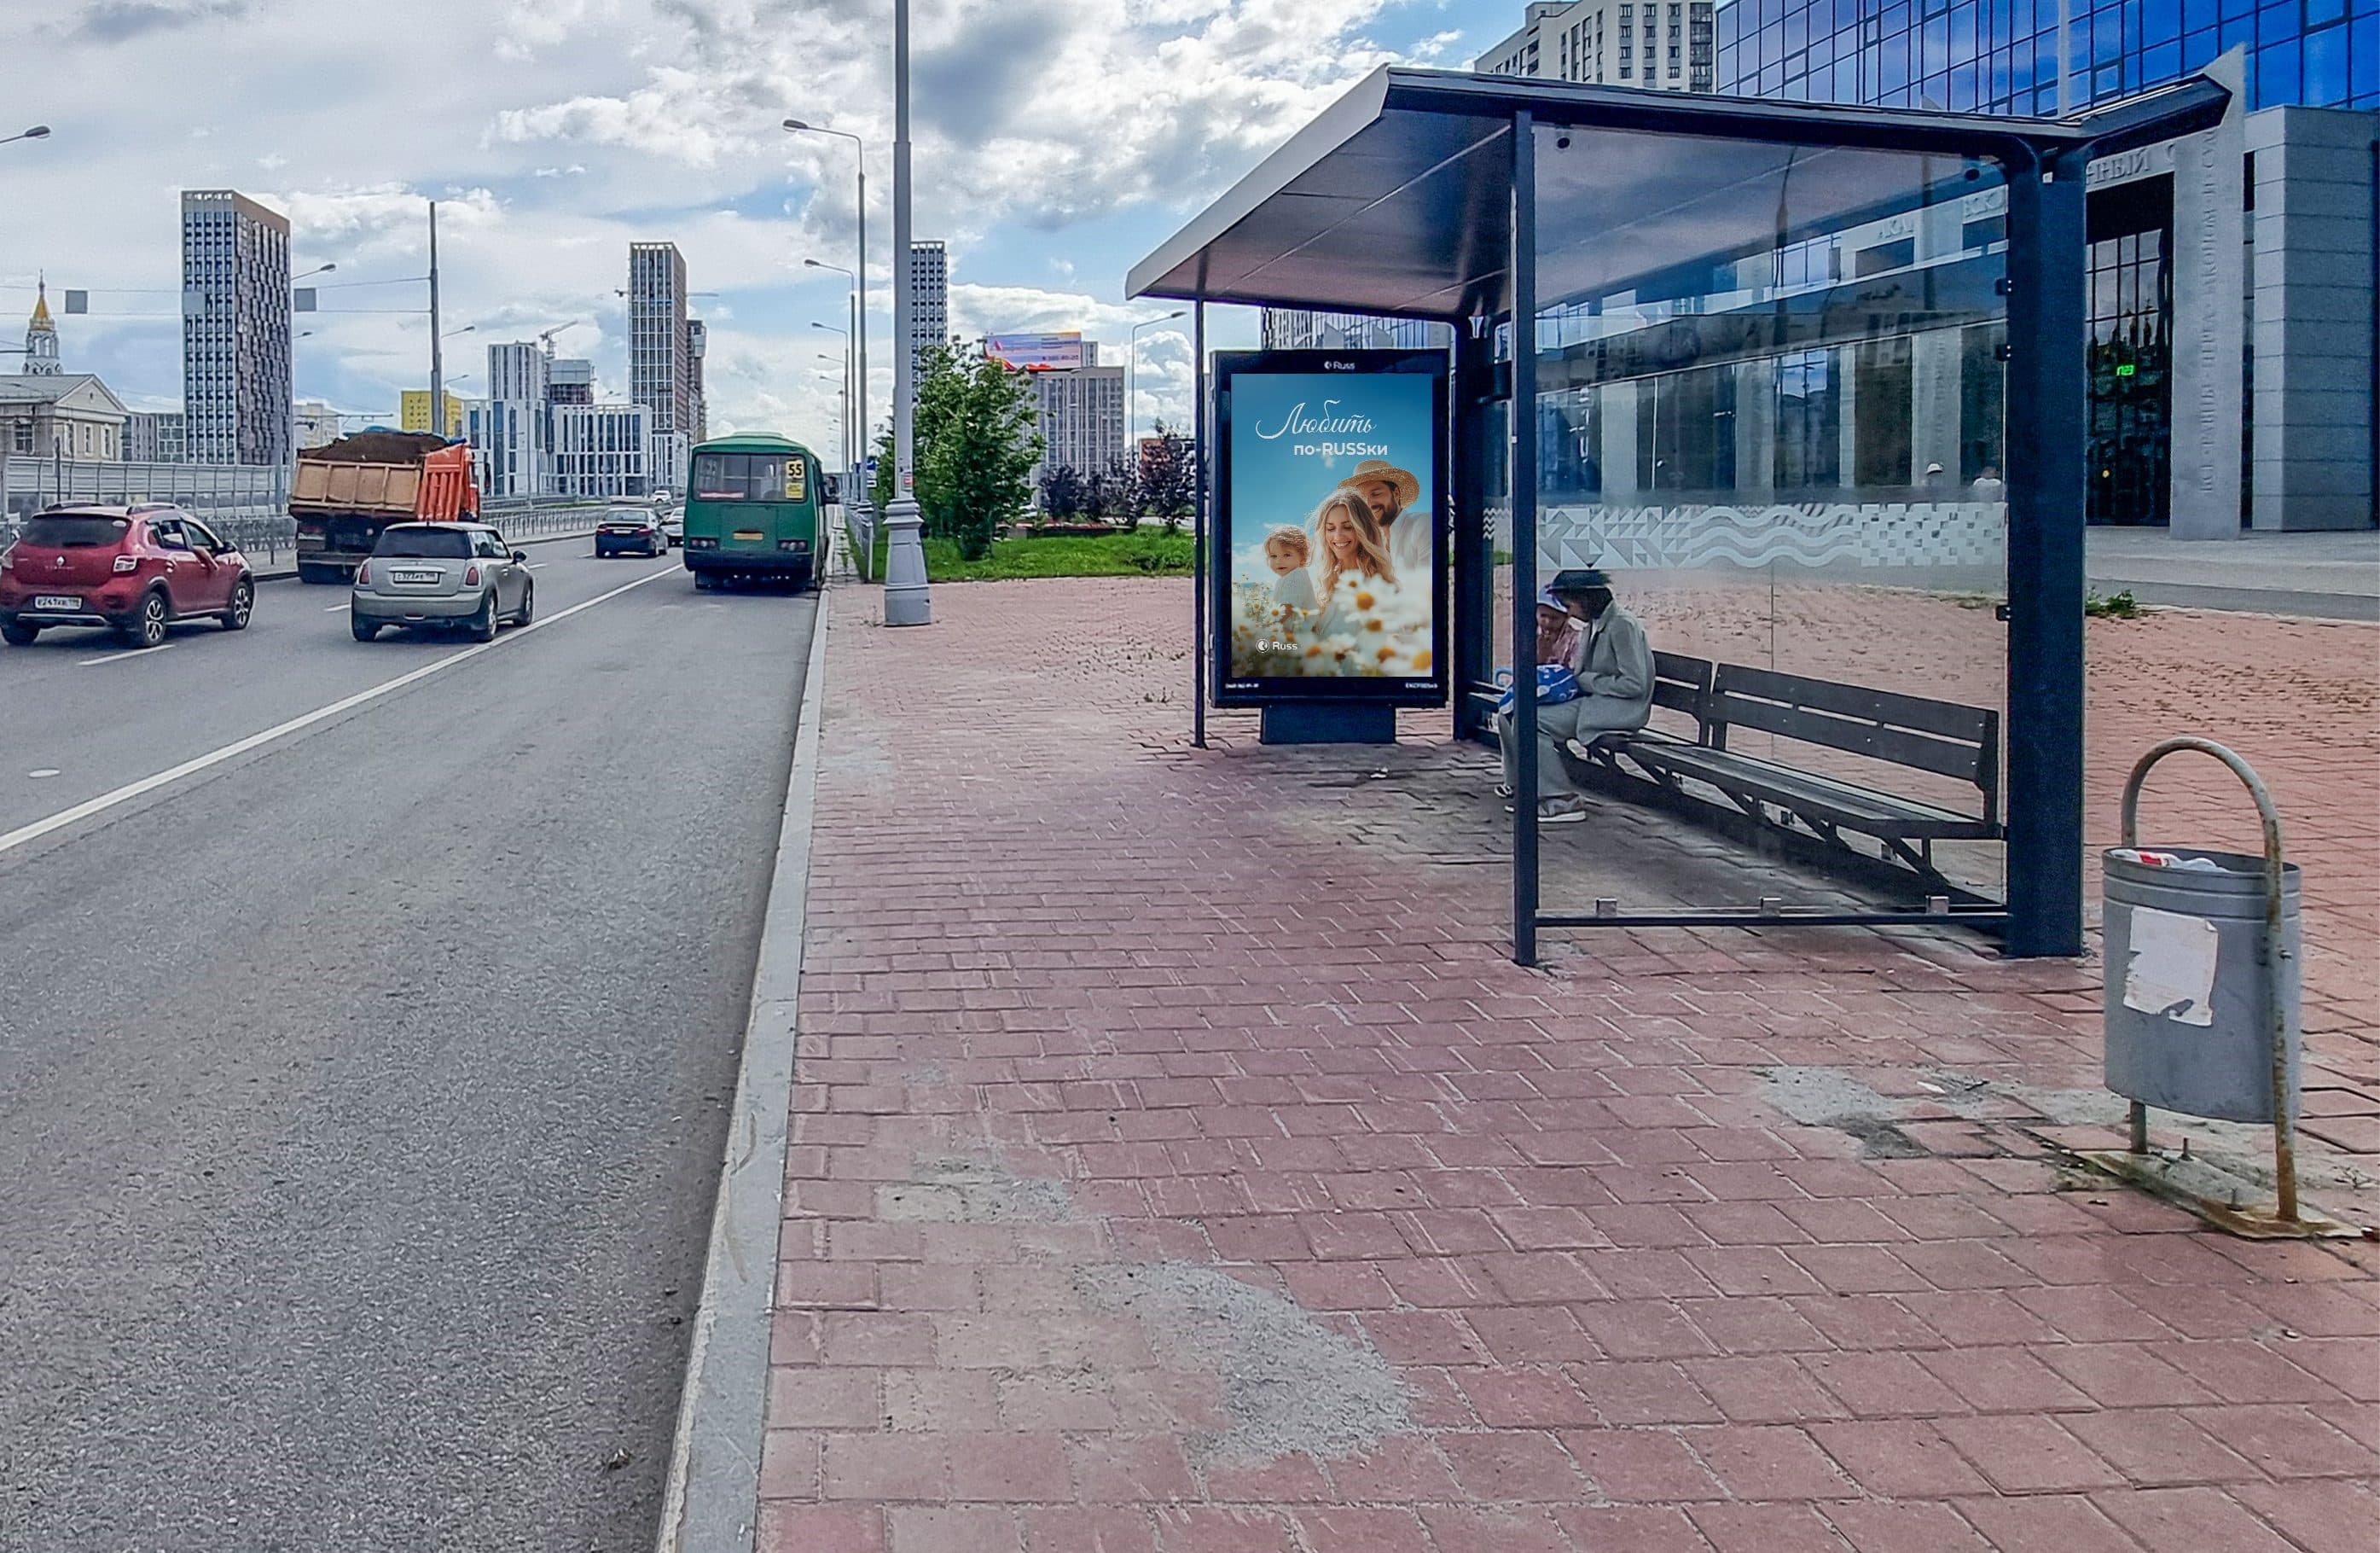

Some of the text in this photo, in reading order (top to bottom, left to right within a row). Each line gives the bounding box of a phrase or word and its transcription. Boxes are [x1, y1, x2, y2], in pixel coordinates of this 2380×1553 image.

[1332, 360, 1355, 370] Russ
[1255, 399, 1378, 440] Любить
[1293, 442, 1388, 457] по-RUSSки
[788, 463, 803, 476] 55
[1272, 641, 1298, 650] Russ
